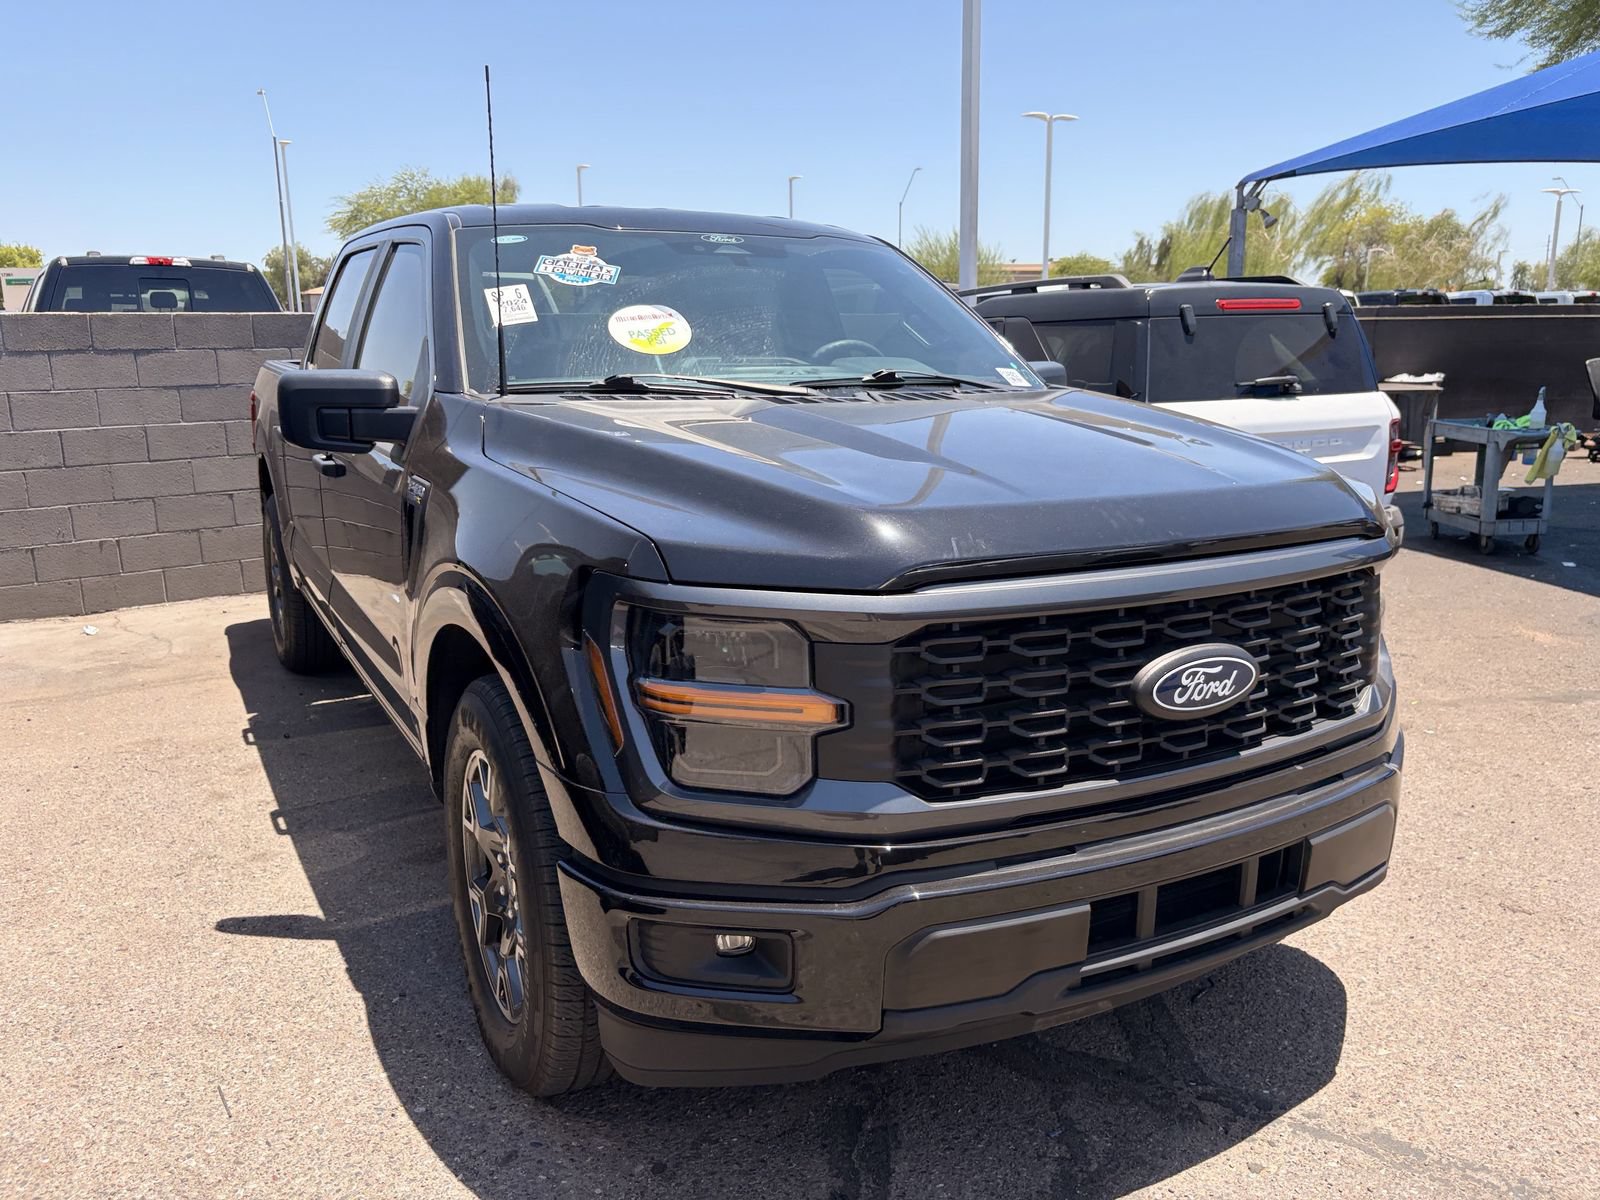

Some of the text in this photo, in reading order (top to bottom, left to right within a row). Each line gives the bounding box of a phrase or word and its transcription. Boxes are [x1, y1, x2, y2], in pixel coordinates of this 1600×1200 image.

[543, 258, 613, 274] CARFAX
[627, 327, 677, 339] PASSED
[1173, 665, 1238, 704] Ford
